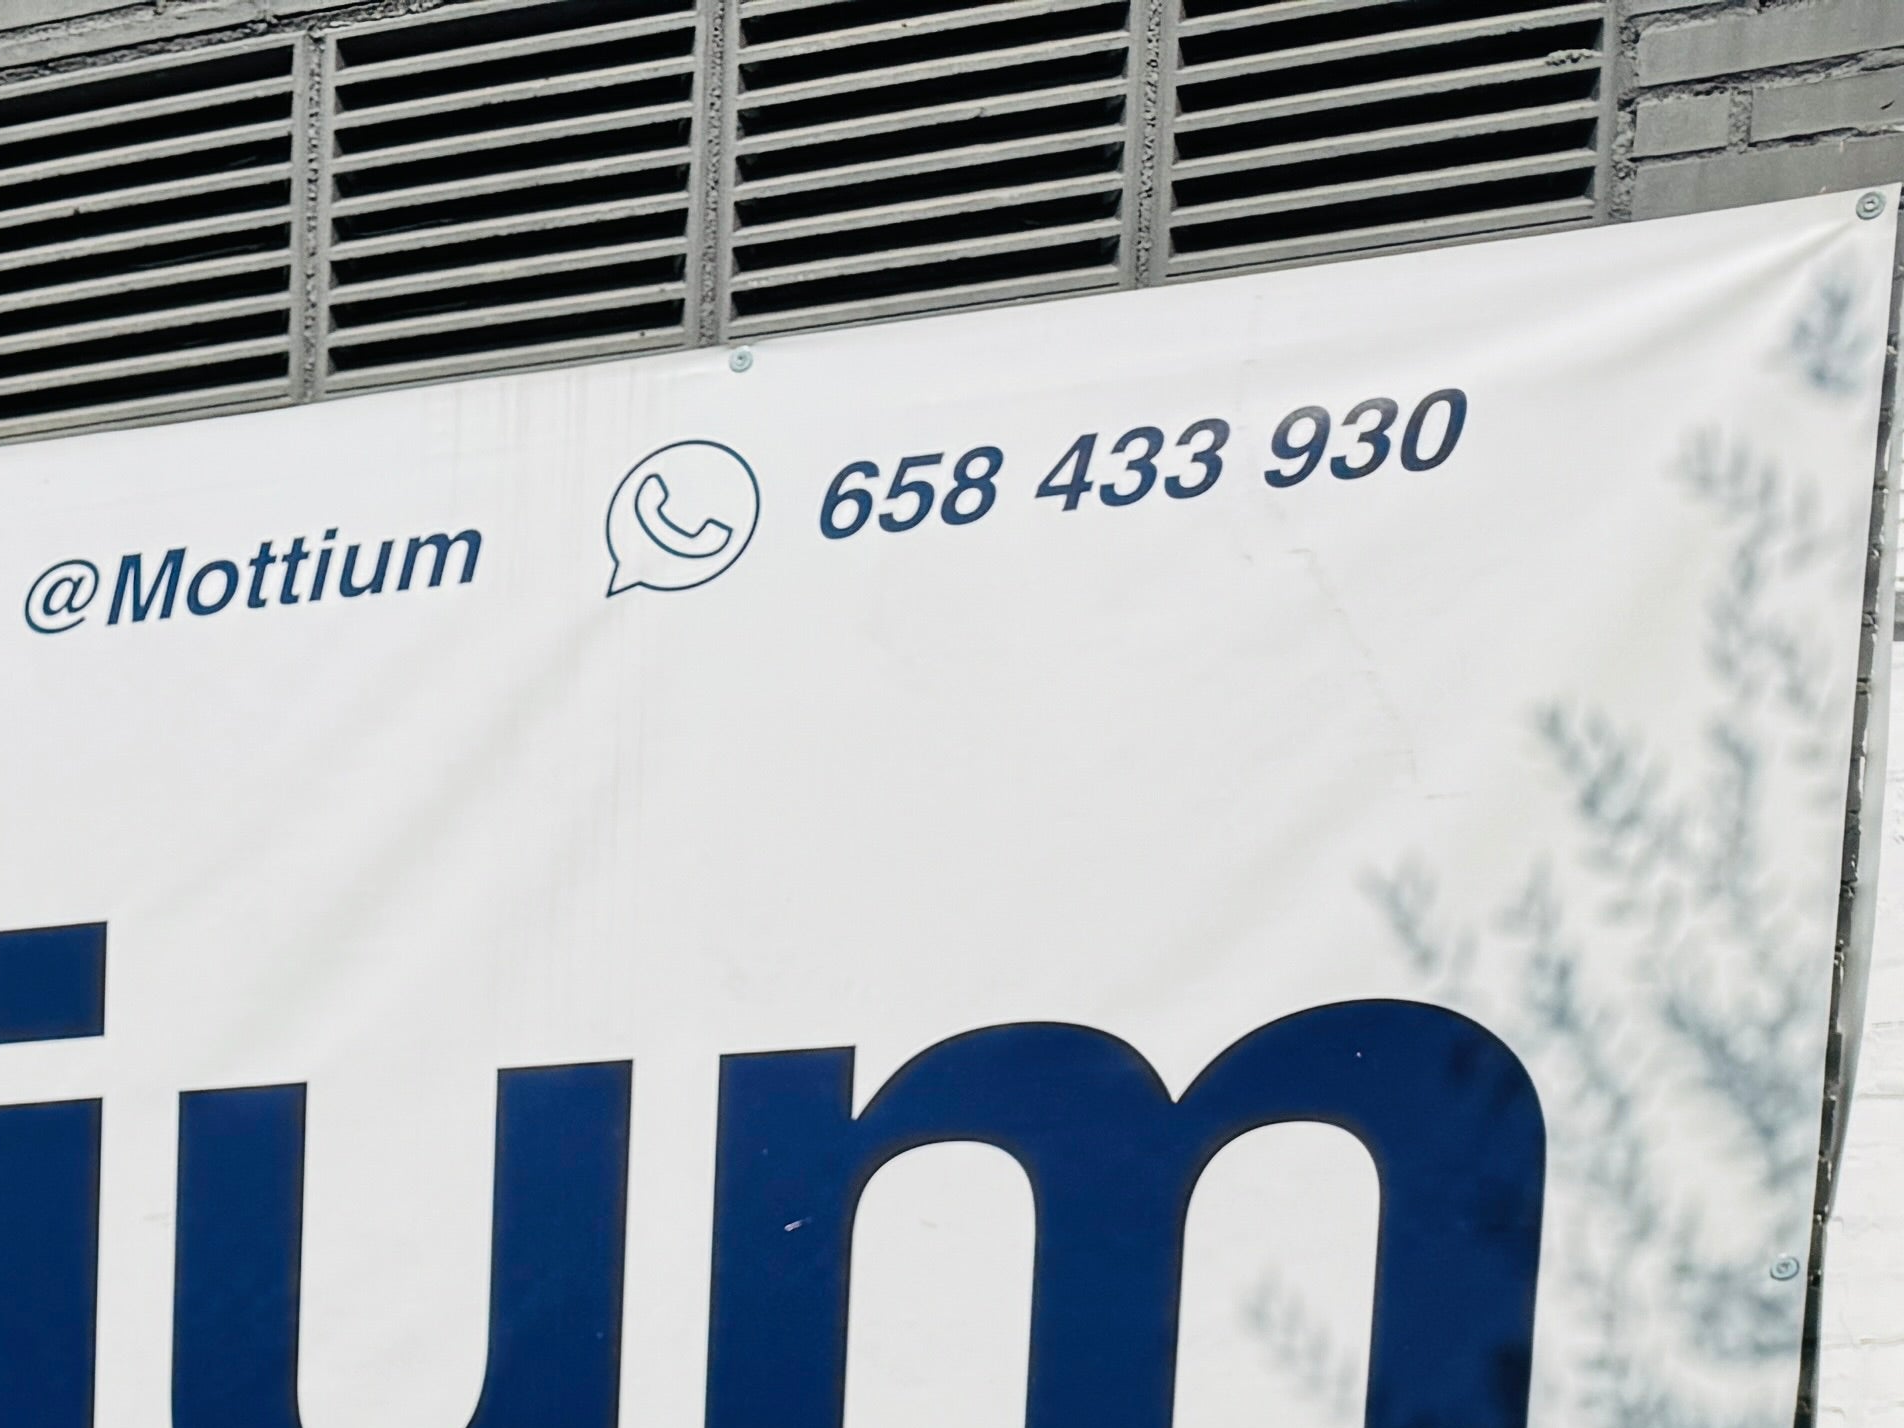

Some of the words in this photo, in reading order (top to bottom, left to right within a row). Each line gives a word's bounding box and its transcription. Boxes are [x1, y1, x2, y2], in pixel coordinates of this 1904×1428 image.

[819, 446, 1004, 540] 658
[1034, 418, 1231, 512] 433
[1264, 388, 1468, 489] 930
[24, 527, 482, 634] @Mottium
